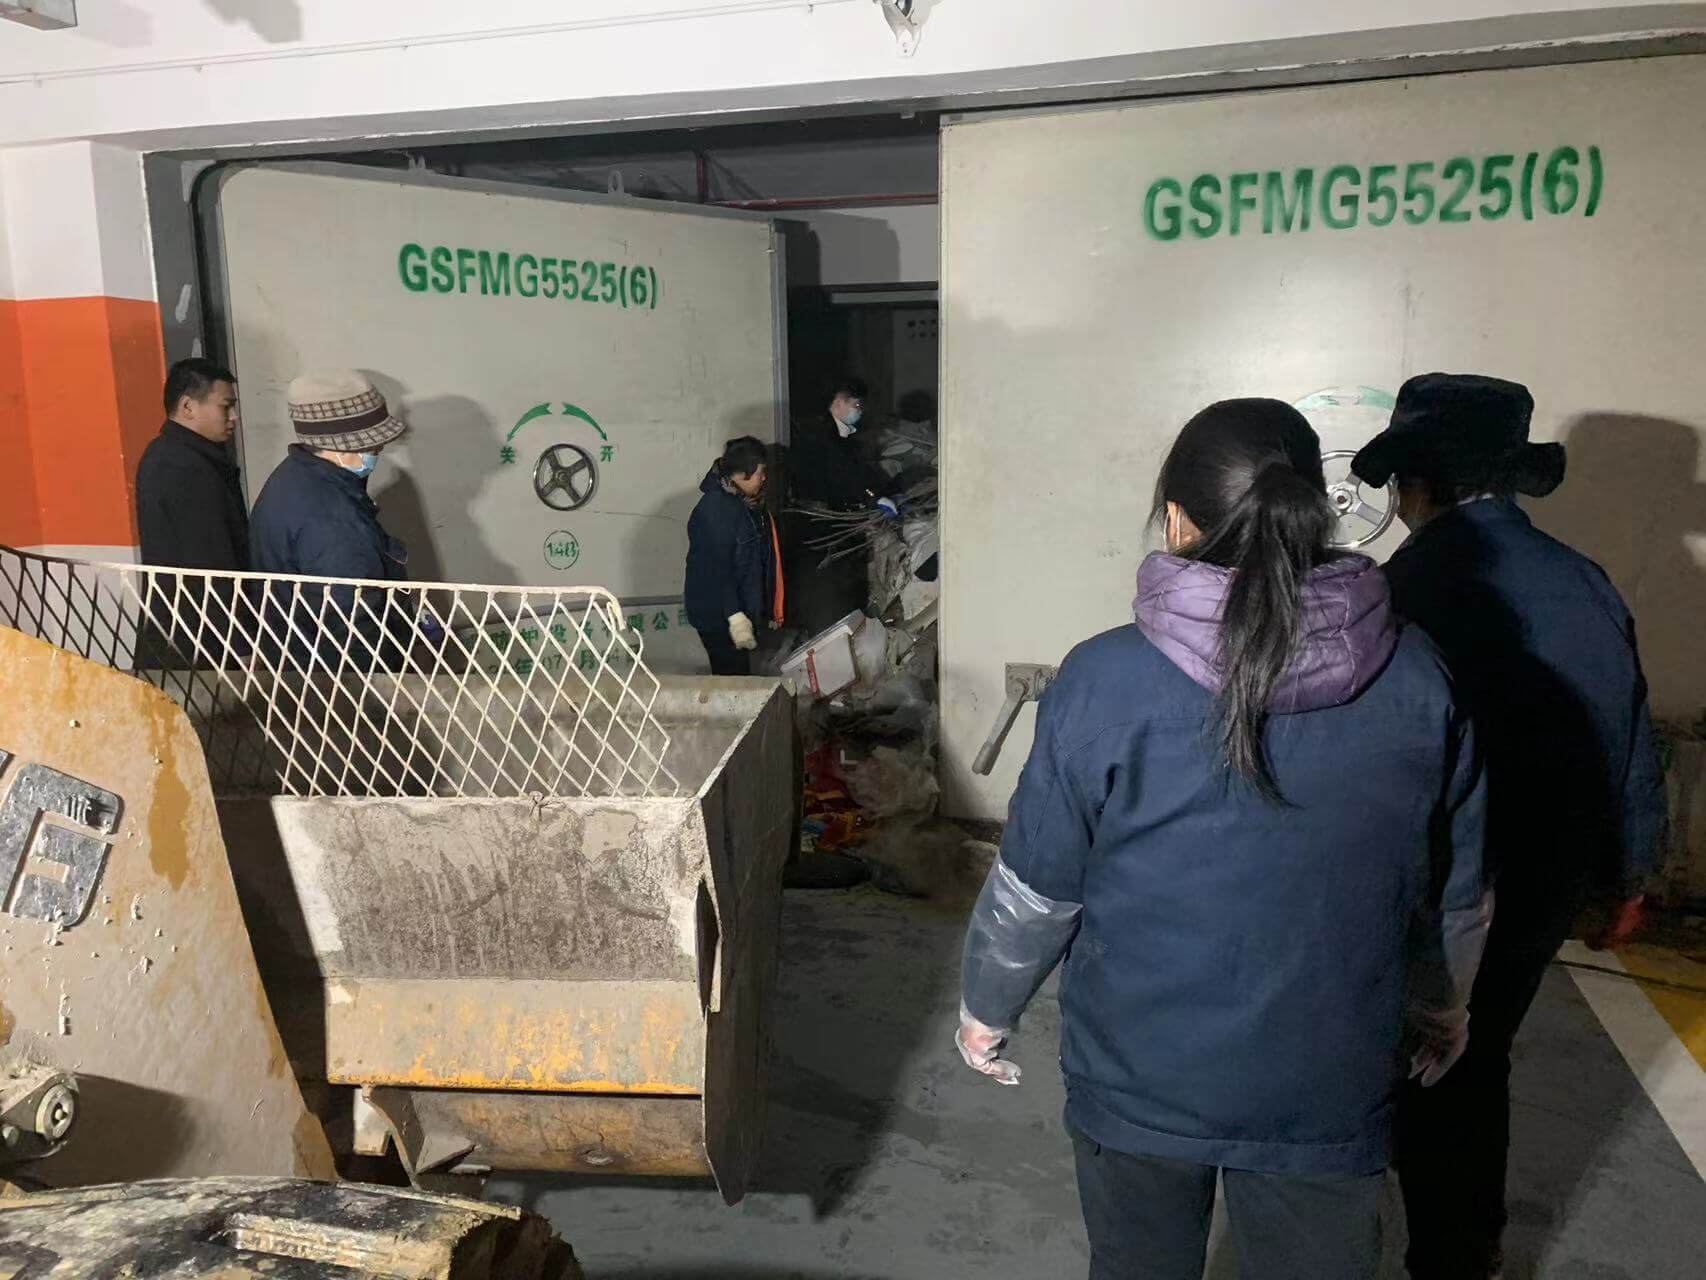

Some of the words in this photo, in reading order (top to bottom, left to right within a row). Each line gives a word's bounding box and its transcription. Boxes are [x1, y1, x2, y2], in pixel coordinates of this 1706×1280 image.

[1145, 145, 1602, 241] GSFMG5525(6)
[399, 243, 657, 309] GSFMG5525(6)
[501, 446, 515, 463] 关
[601, 446, 613, 462] 开
